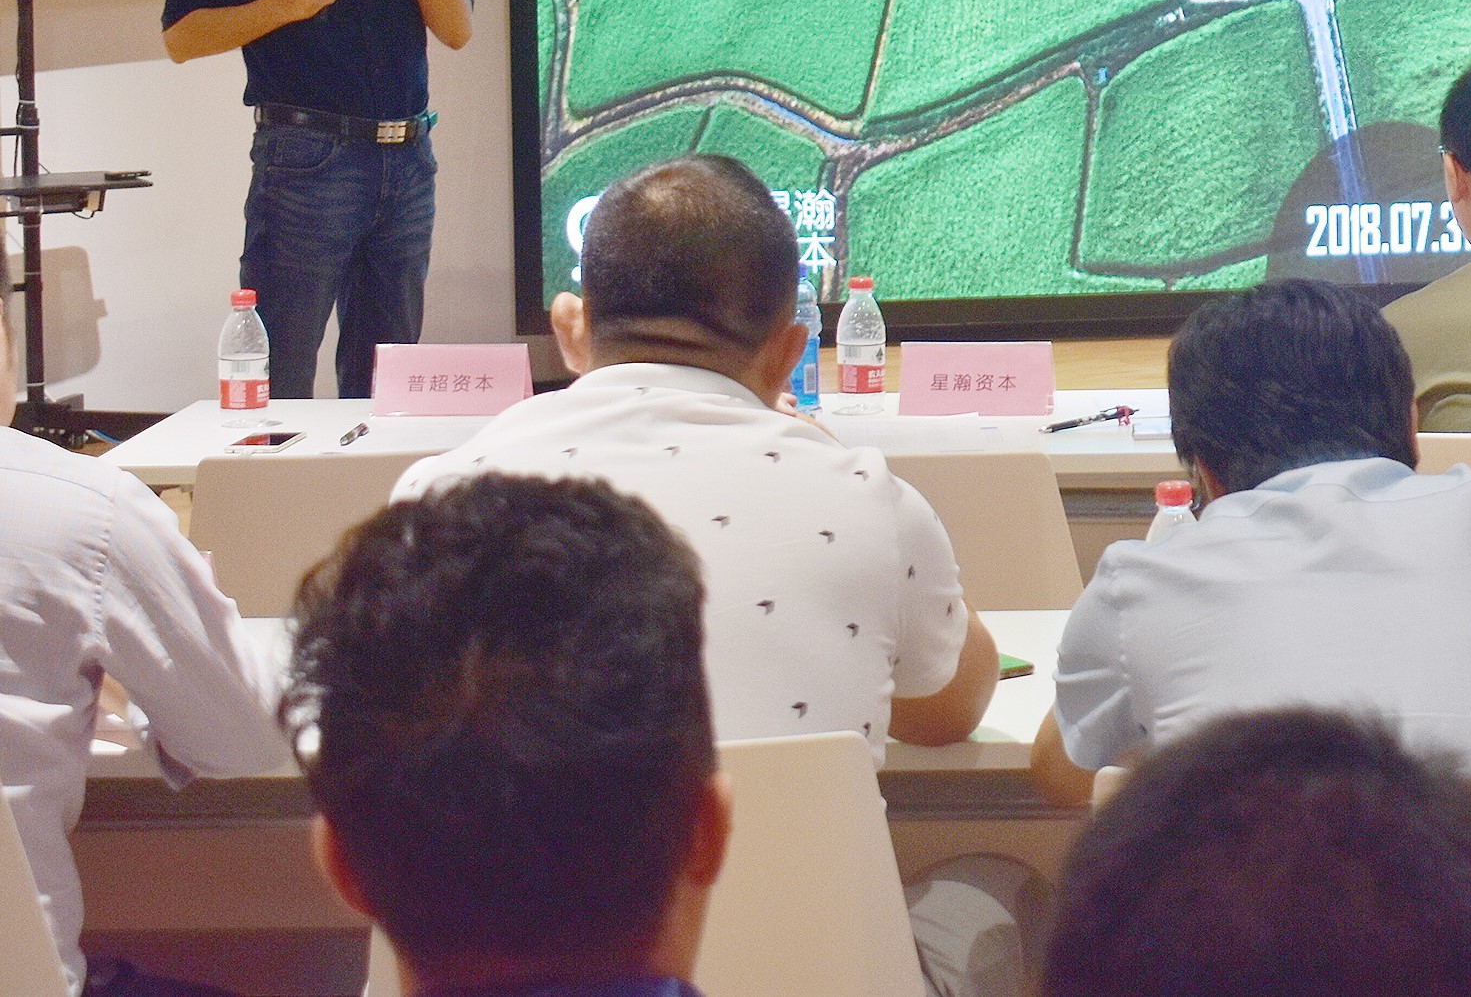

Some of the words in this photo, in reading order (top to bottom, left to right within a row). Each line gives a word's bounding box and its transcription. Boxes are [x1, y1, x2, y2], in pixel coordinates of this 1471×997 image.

[407, 374, 494, 393] 普超资本
[930, 373, 1016, 391] 星瀚资本
